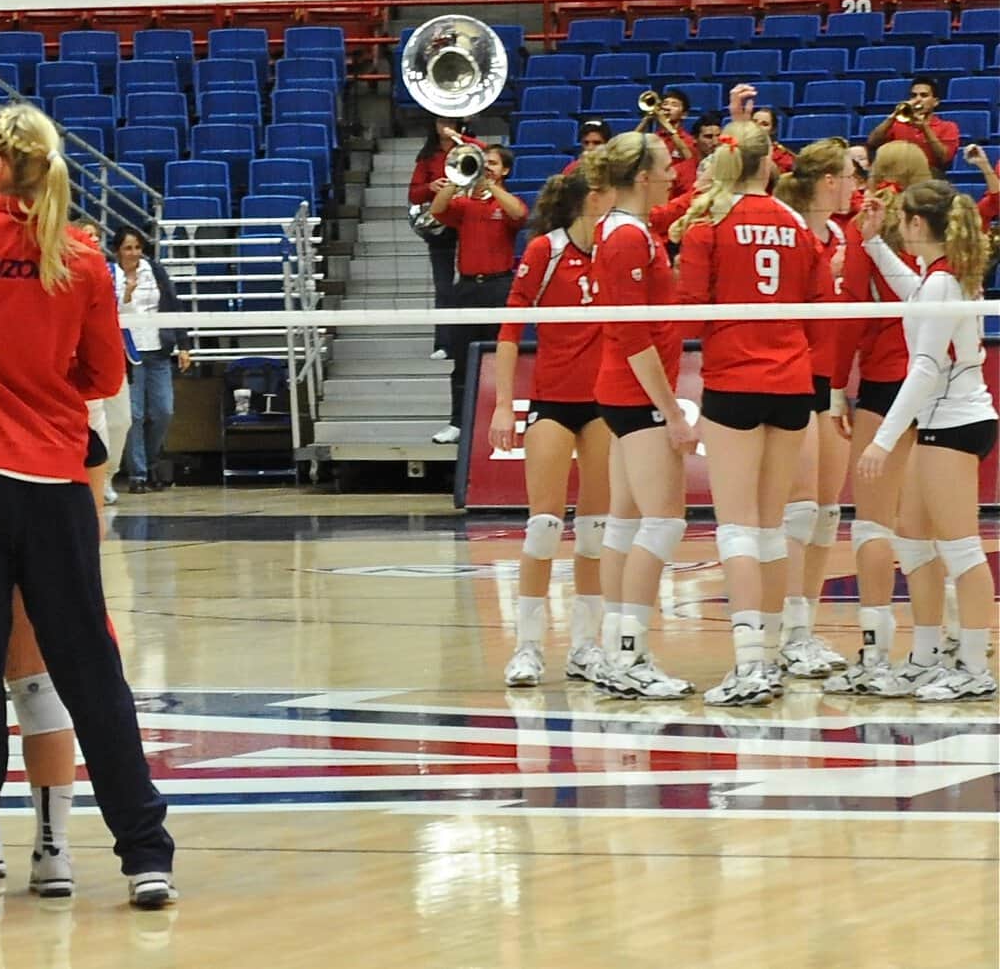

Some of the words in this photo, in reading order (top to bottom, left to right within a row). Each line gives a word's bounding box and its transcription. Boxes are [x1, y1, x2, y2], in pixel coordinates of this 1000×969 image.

[842, 0, 871, 14] 20
[734, 225, 796, 247] UTAH
[755, 249, 780, 295] 9
